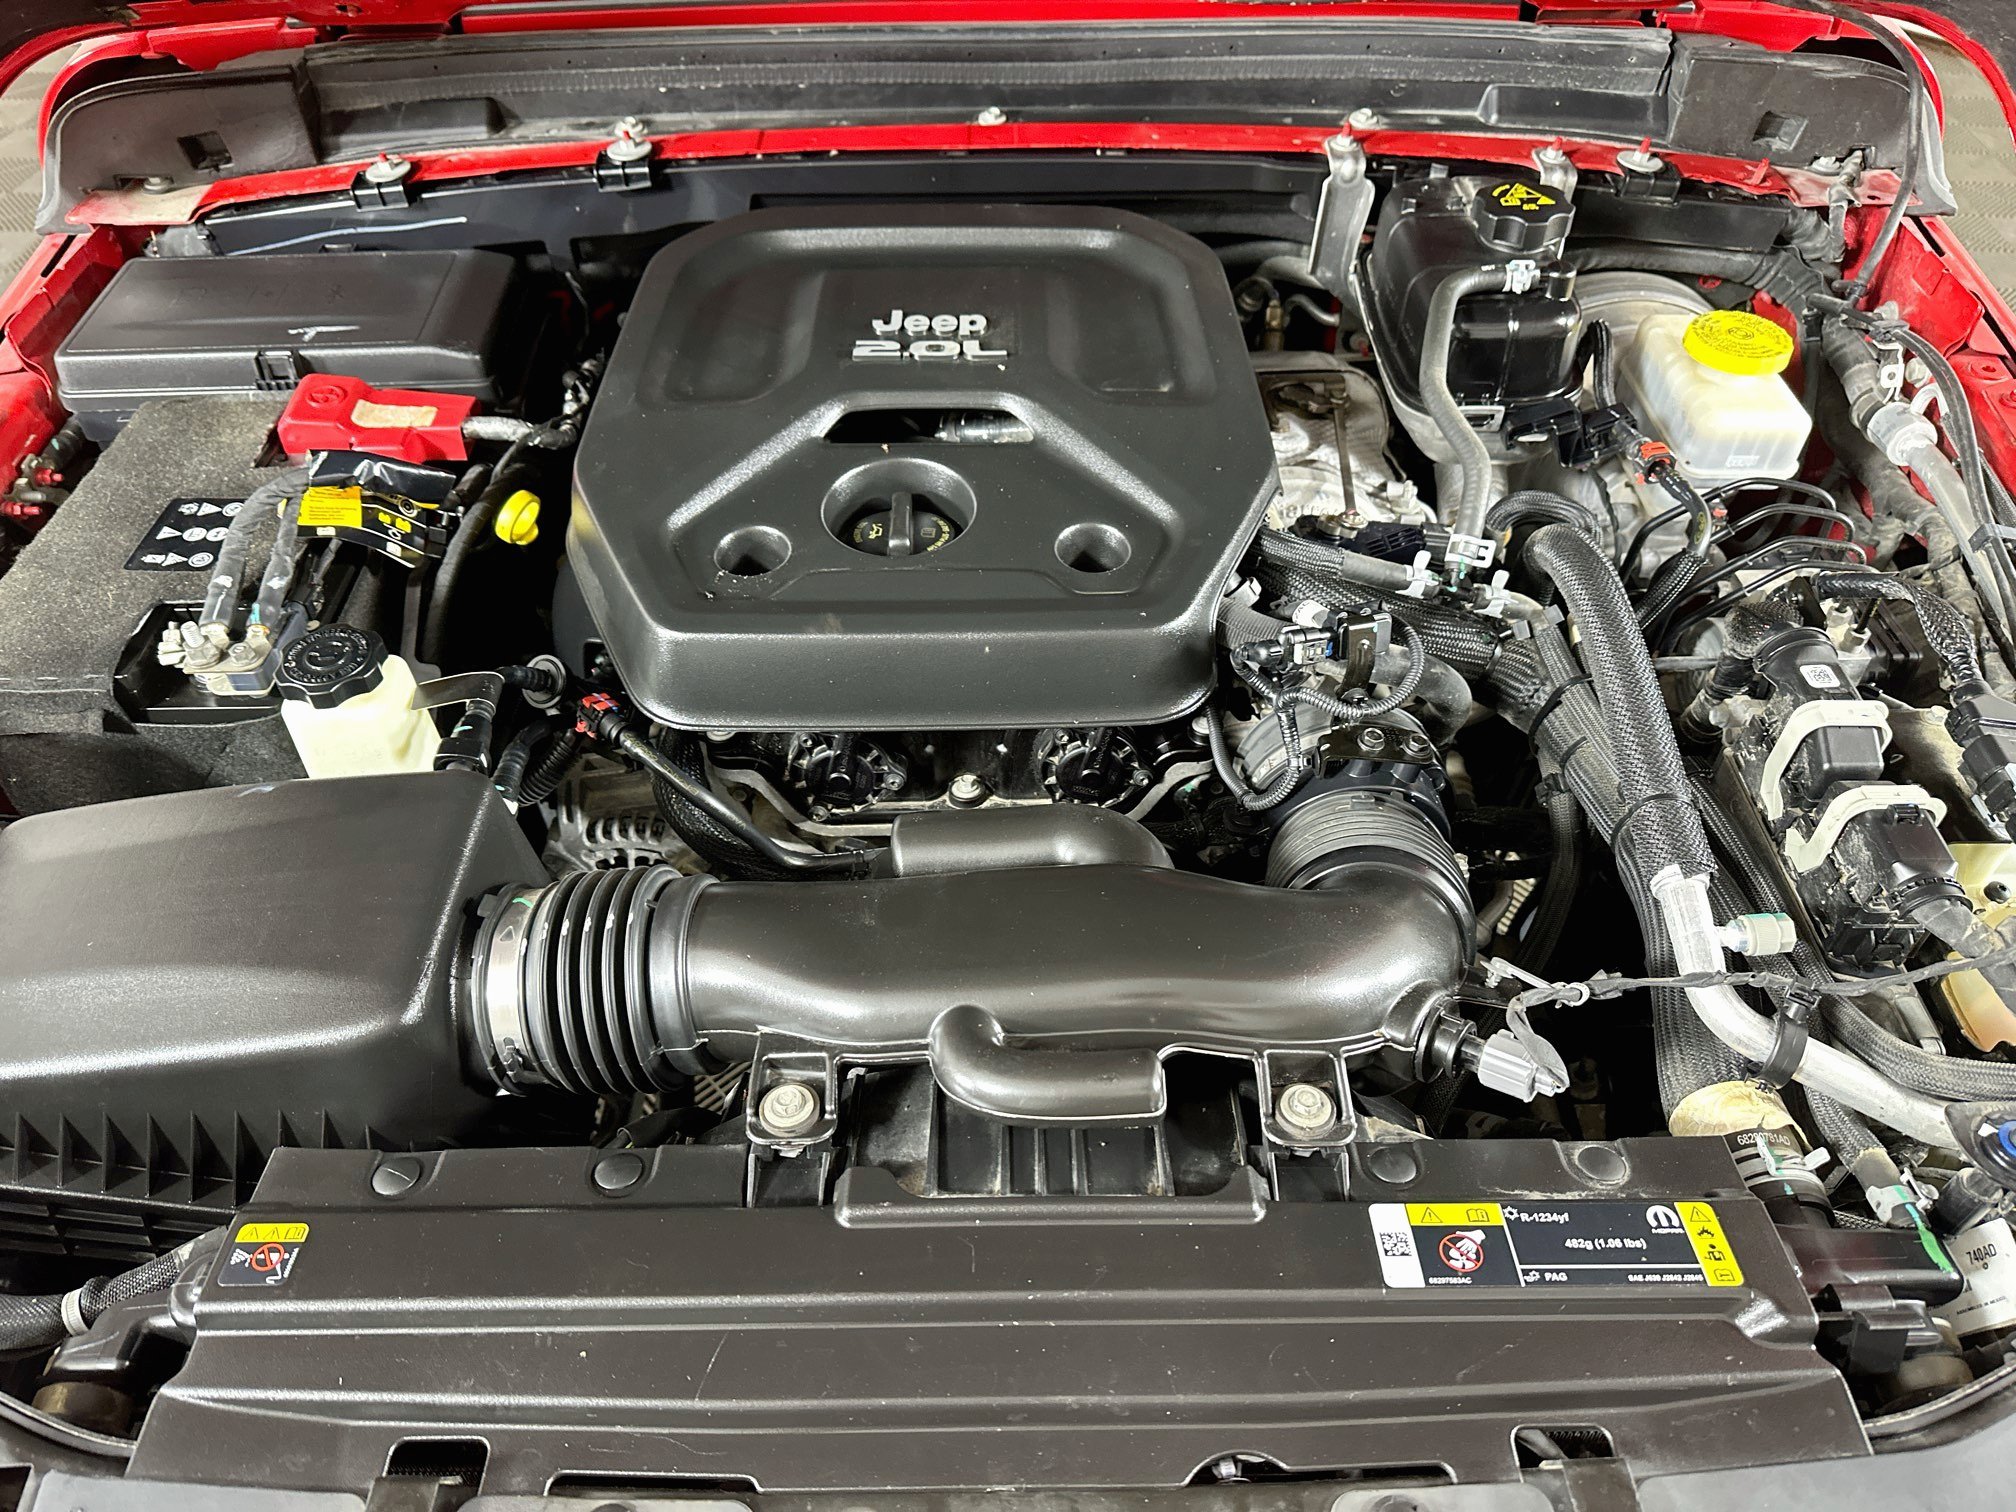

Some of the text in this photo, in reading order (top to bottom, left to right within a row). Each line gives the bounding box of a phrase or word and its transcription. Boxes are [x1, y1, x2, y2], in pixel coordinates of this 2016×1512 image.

[871, 309, 988, 338] Jeep
[852, 340, 1008, 361] 2.0L
[661, 763, 700, 796] BRAKE
[1564, 1238, 1594, 1250] 482g
[1623, 1238, 1647, 1250] lbs)
[1965, 1243, 1998, 1265] 740AD
[1544, 1272, 1568, 1282] PAG
